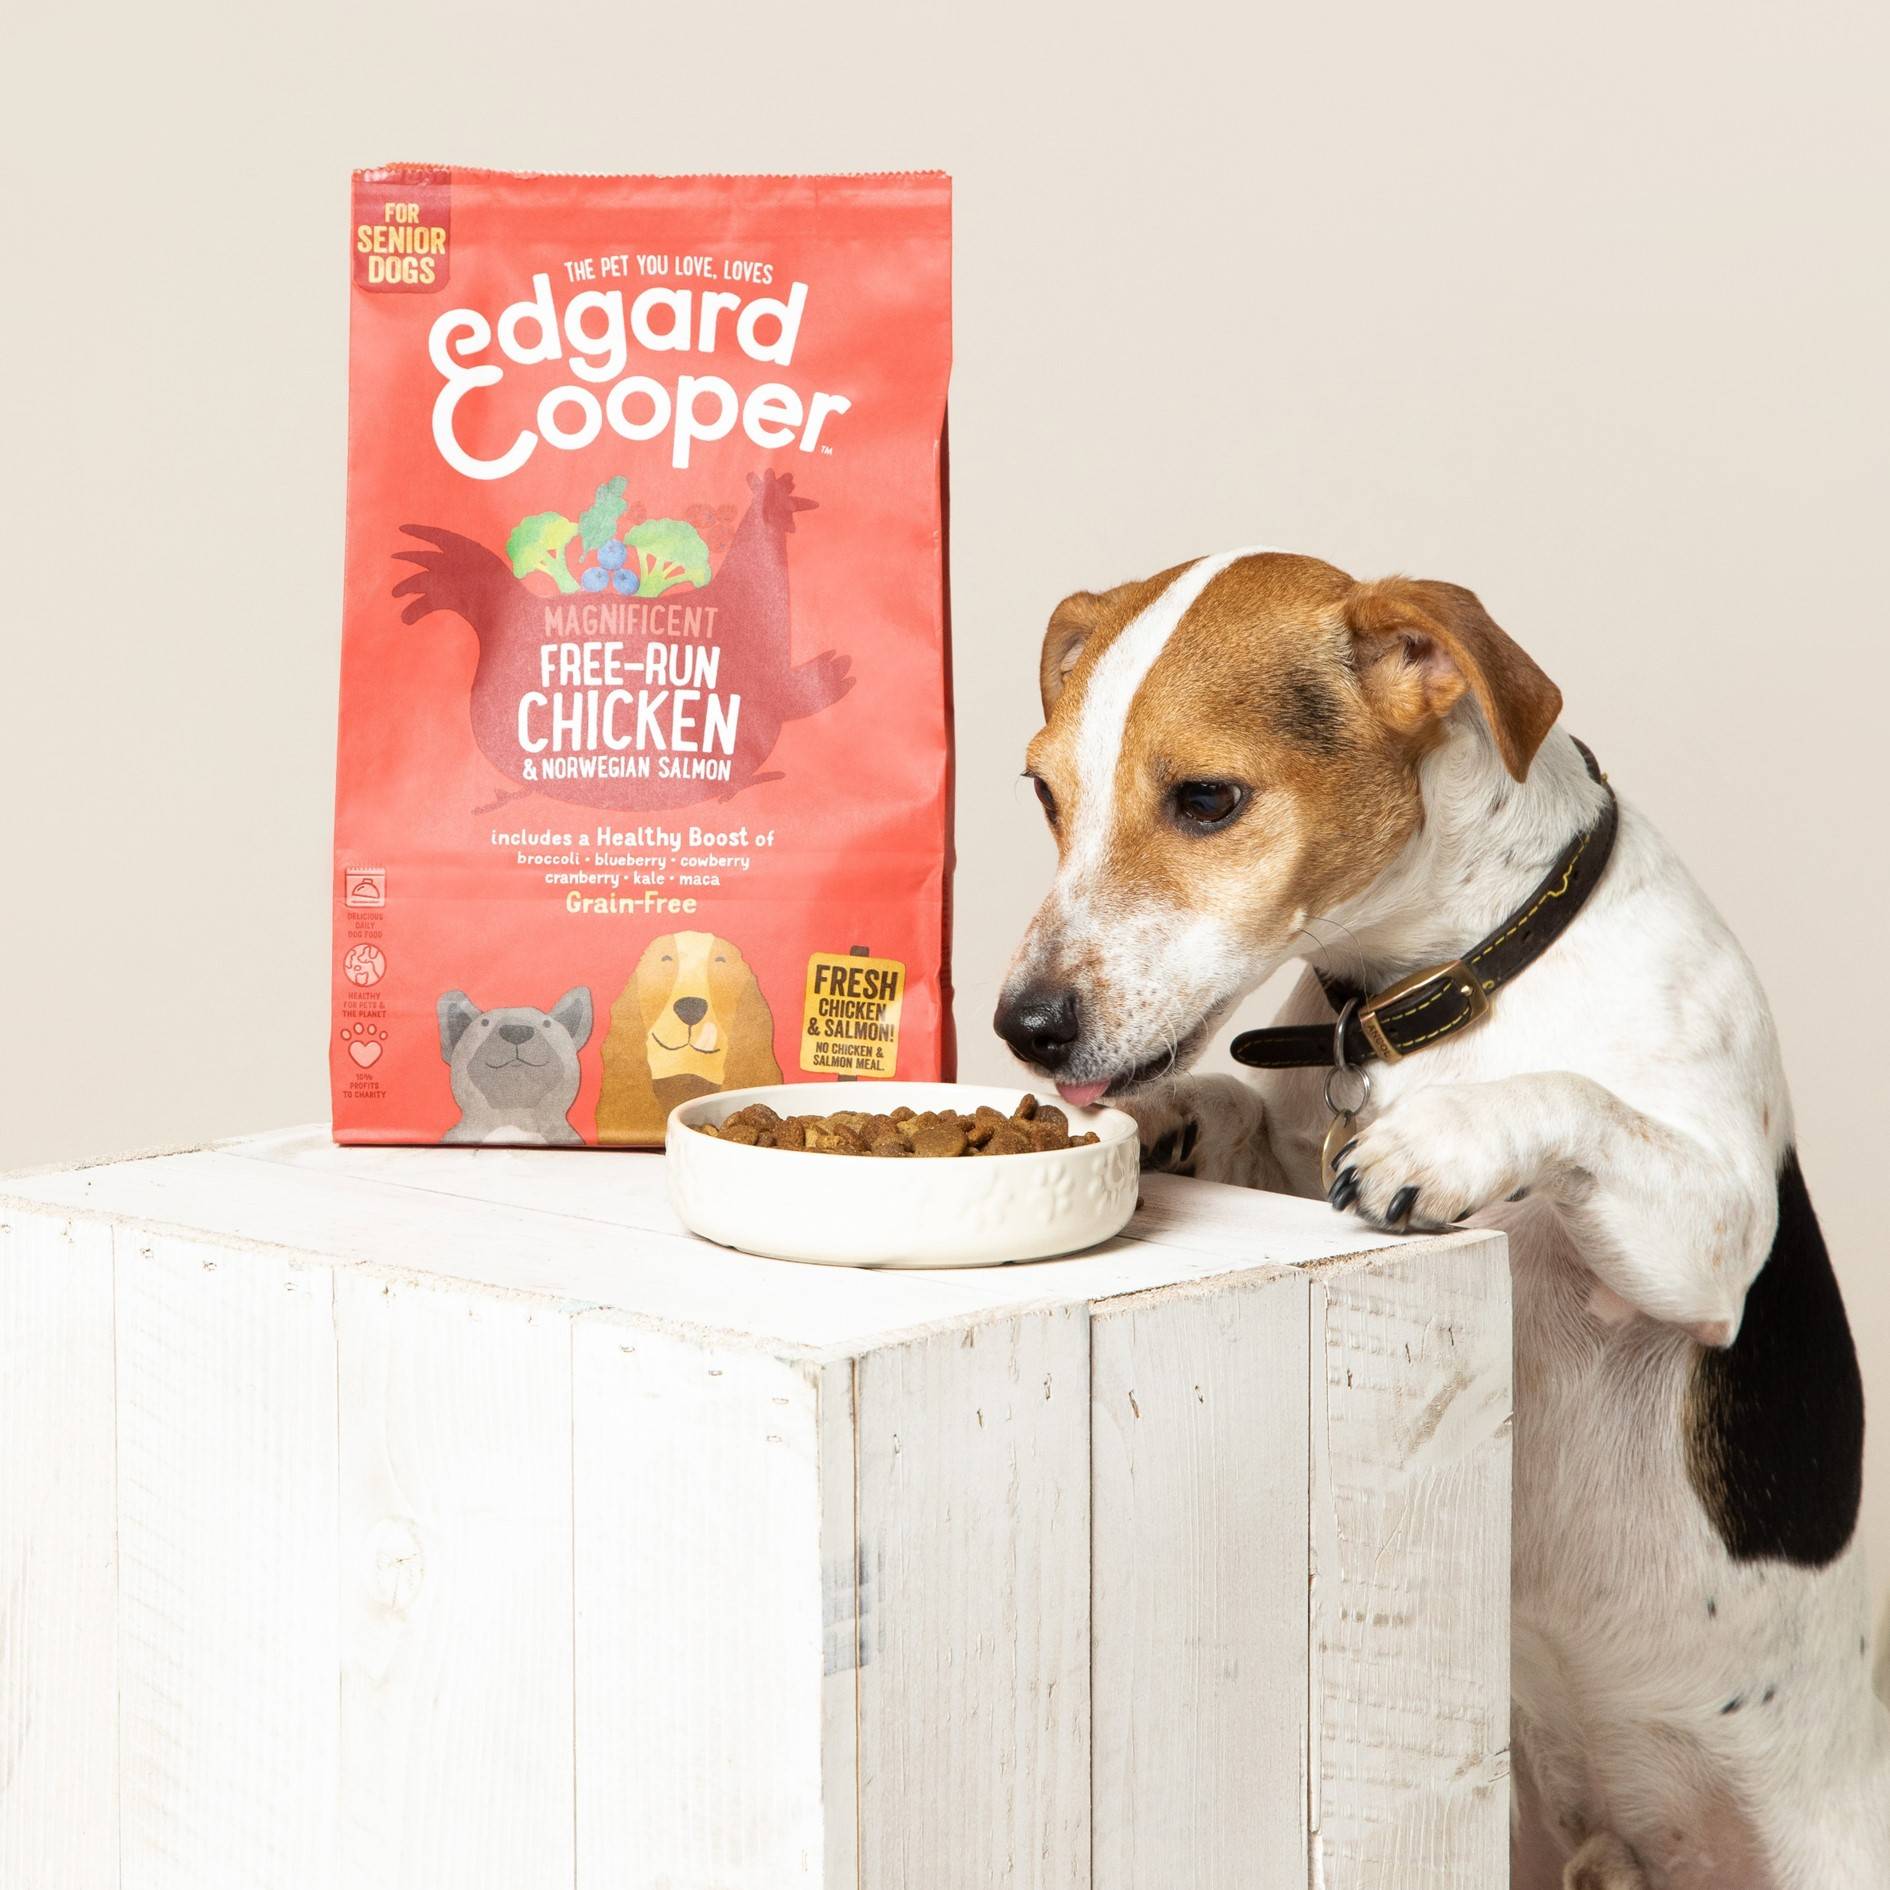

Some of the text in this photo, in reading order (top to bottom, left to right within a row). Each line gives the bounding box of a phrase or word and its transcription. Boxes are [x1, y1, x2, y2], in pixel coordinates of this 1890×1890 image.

[385, 202, 419, 224] FOR
[357, 225, 446, 254] SENIOR
[368, 256, 435, 284] DOGS
[564, 255, 774, 285] THE PET YOU LOVE, LOVES
[428, 273, 808, 383] edgard
[431, 364, 852, 480] Cooper
[544, 604, 719, 638] MAGNIFICENT
[540, 641, 721, 689] FREE-RUN
[517, 689, 741, 755] CHICKEN
[522, 756, 732, 782] & NORWEGIAN SALMON
[491, 826, 776, 852] includes a Healthy Boost of
[517, 851, 750, 871] broccoli blueberry cowberry
[544, 871, 720, 889] cranberry kale maca
[566, 890, 698, 914] Grain-Free
[814, 964, 898, 1001] FRESH
[348, 991, 381, 1000] HEALTHY
[342, 1010, 386, 1018] THE PLANET
[818, 998, 886, 1021] CHICKEN
[807, 1017, 893, 1041] & SALMON!
[813, 1054, 853, 1069] SALMON
[815, 1042, 884, 1058] NO CHICKEN &
[350, 1082, 379, 1090] PROFITS
[354, 1090, 386, 1098] CHARITY
